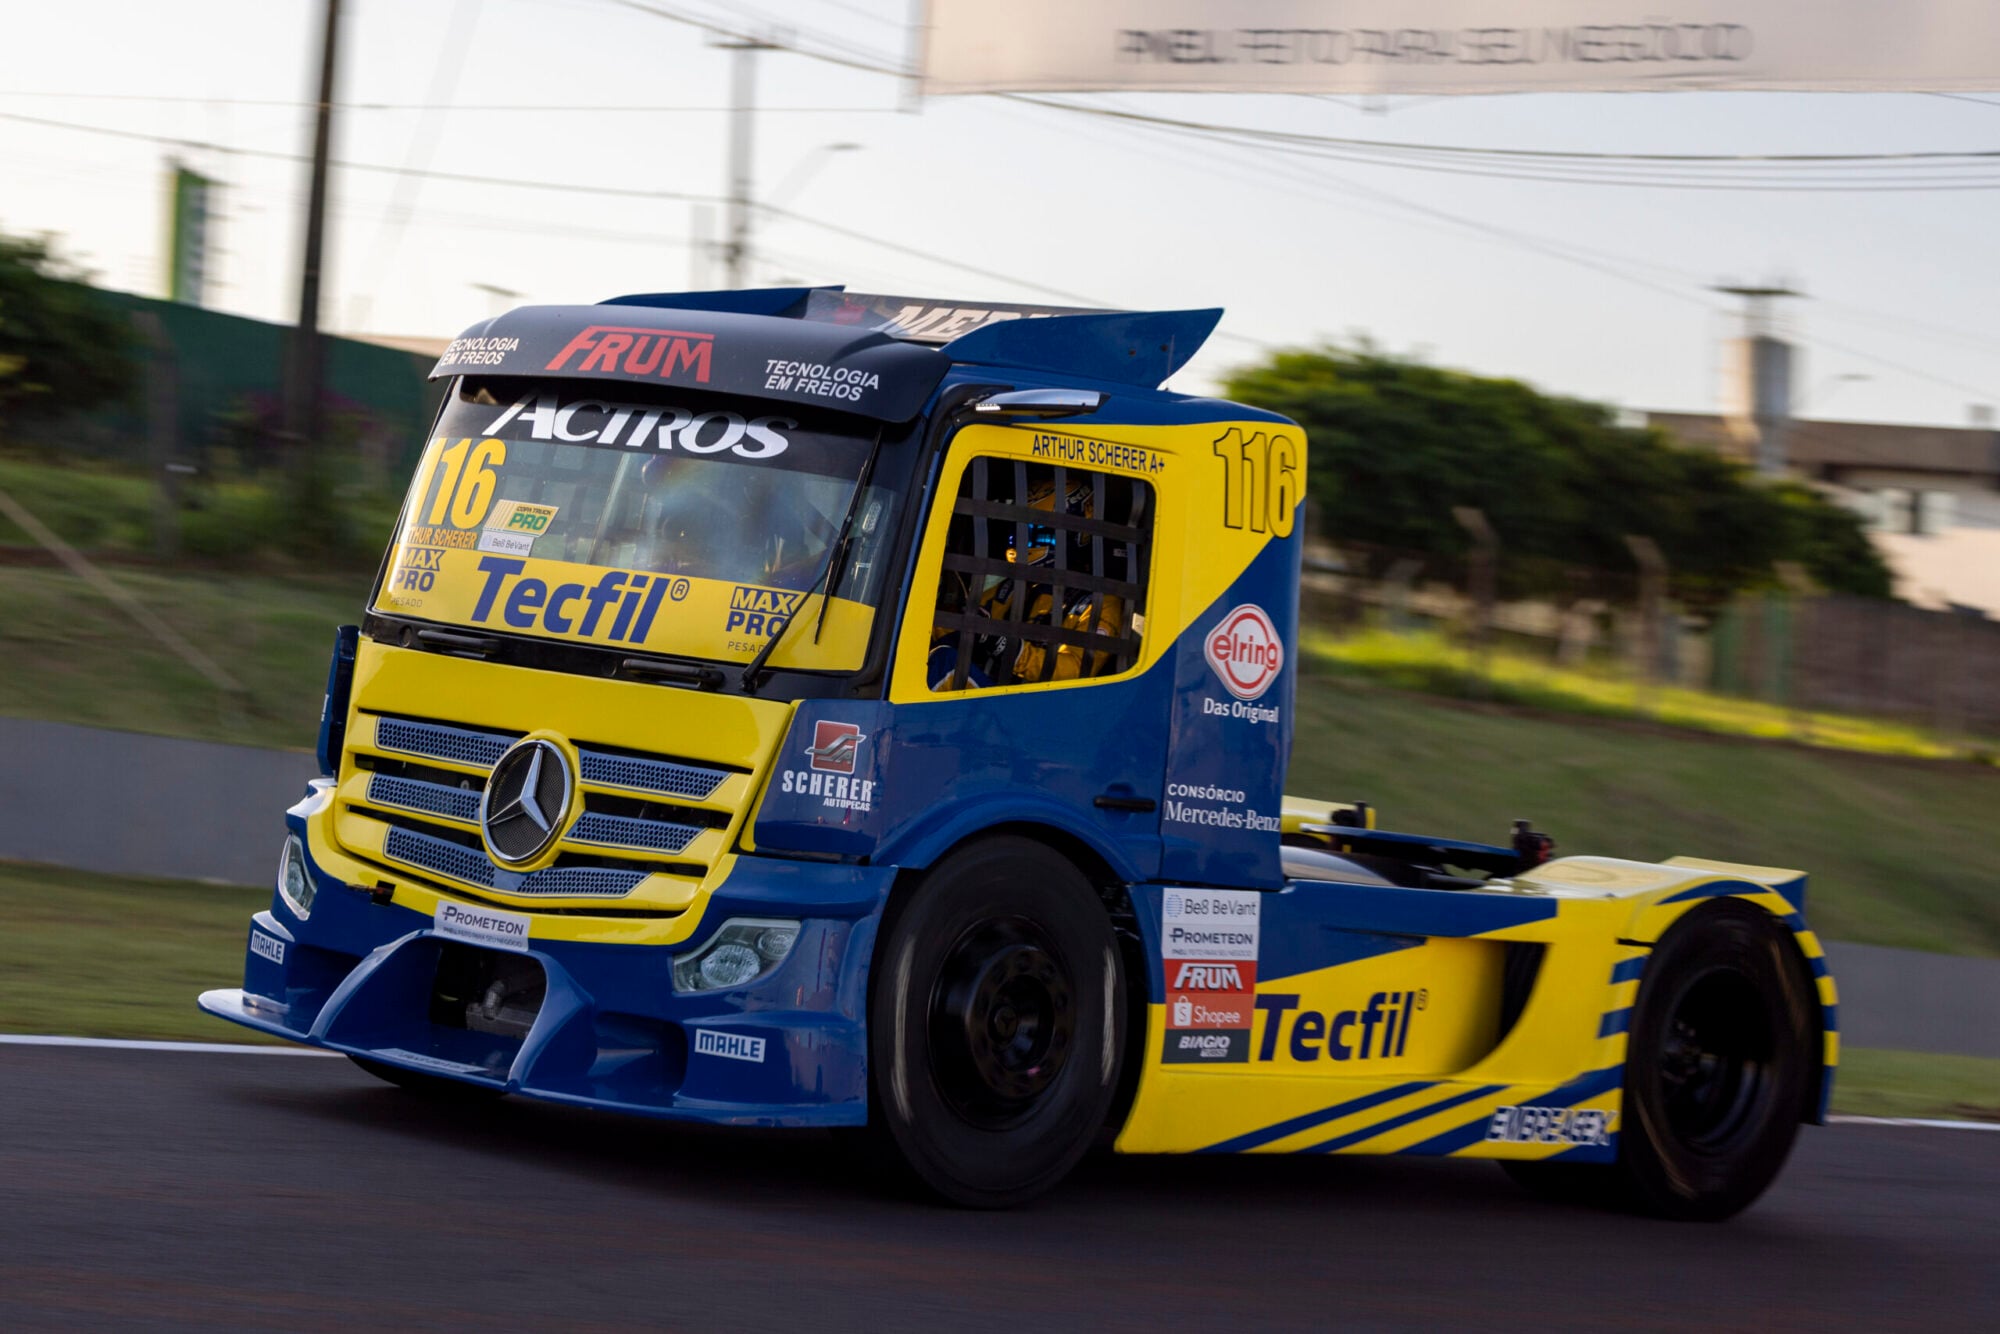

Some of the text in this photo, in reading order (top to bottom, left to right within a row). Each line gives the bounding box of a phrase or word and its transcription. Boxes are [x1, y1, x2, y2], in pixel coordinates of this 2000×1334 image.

[440, 351, 505, 367] EM FREIOS
[544, 326, 716, 383] FRUM
[765, 359, 880, 390] TECNOLOGIA
[764, 375, 863, 402] EM FREIOS
[482, 396, 799, 459] ACTROS
[1032, 434, 1085, 461] ARTHUR
[1088, 441, 1147, 471] SCHERER
[411, 437, 507, 530] 116
[1213, 427, 1297, 539] 116
[508, 513, 547, 531] PRO
[433, 527, 478, 550] SCHERER
[505, 539, 530, 551] BeVant
[401, 549, 442, 571] MAX
[395, 570, 435, 592] PRO
[391, 597, 423, 608] PESADO
[731, 587, 799, 616] MAX
[1213, 633, 1278, 671] elring
[1203, 698, 1279, 724] Das Original
[782, 770, 873, 802] SCHERER
[1167, 783, 1246, 803] CONSÓRCIO
[1164, 800, 1280, 832] Mercedes-Benz
[442, 905, 525, 936] PROMETEON
[1184, 898, 1256, 916] Be8 BeVant
[252, 933, 283, 960] MAHLE
[1169, 928, 1253, 945] PROMETEON
[1173, 963, 1243, 990] FRUM
[1193, 1006, 1241, 1028] Shopee
[698, 1032, 761, 1059] MAHLE
[1178, 1035, 1231, 1049] BIAGIO
